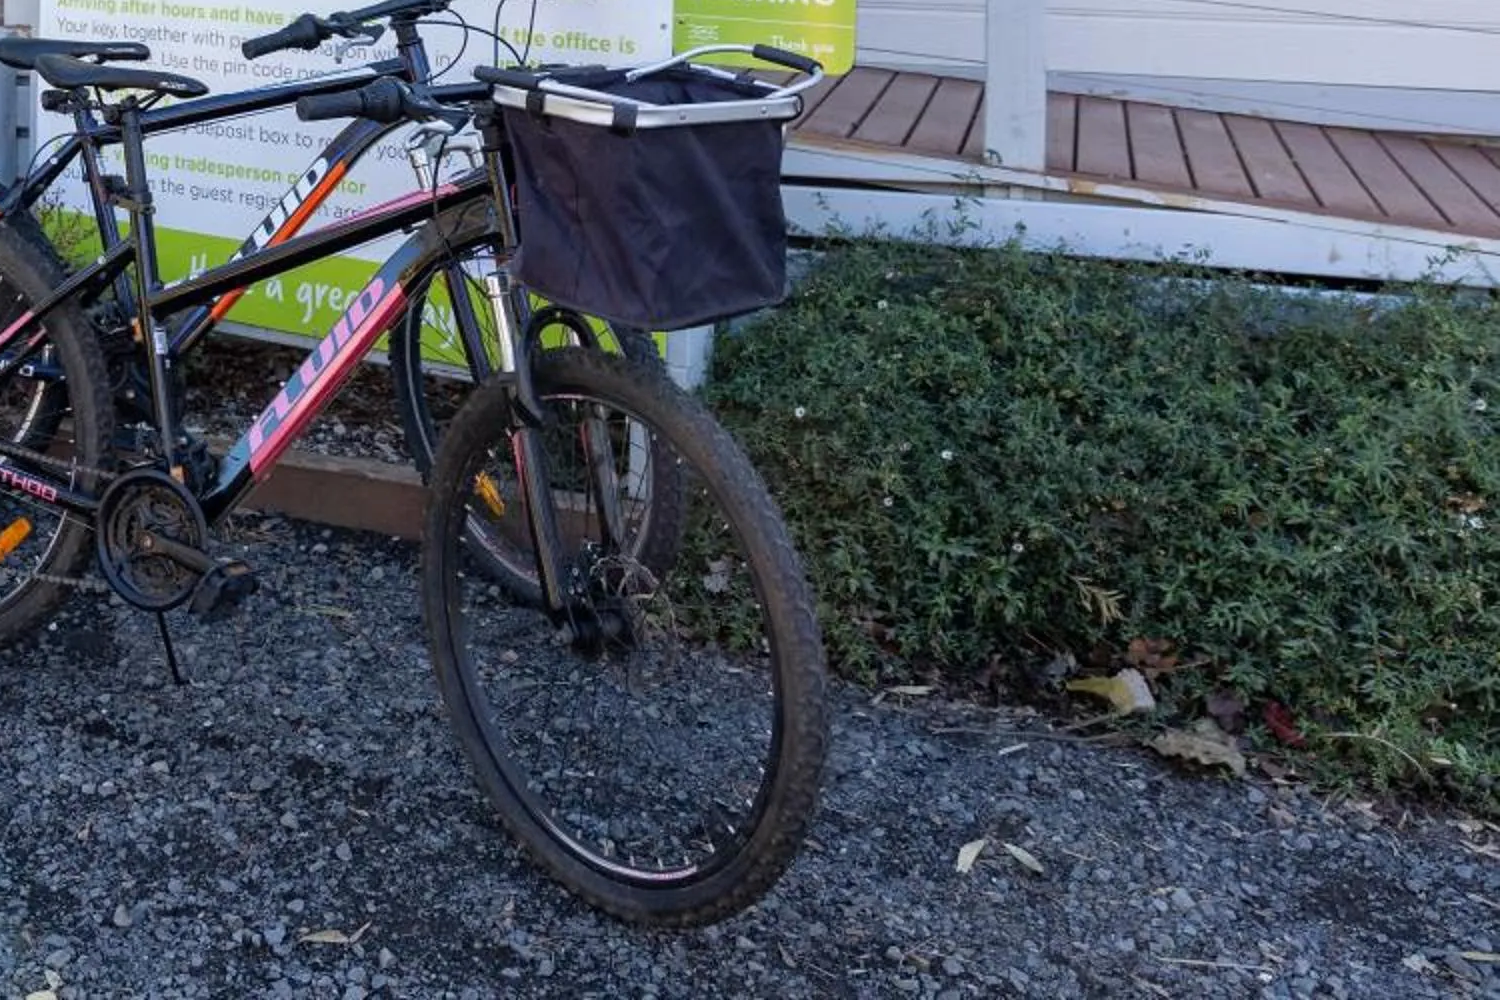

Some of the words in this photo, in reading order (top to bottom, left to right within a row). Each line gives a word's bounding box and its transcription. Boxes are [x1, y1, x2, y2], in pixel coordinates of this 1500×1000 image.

[161, 0, 204, 19] hours
[210, 4, 239, 22] and
[245, 7, 284, 25] have
[57, 17, 87, 34] Your
[92, 20, 119, 39] key,
[123, 24, 187, 44] together
[192, 28, 225, 46] with
[552, 31, 611, 52] office
[618, 36, 636, 54] is
[161, 52, 189, 70] Use
[193, 55, 218, 72] the
[223, 57, 247, 77] pin
[252, 60, 293, 78] code
[196, 121, 253, 140] deposit
[260, 126, 288, 145] box
[295, 132, 313, 148] to
[175, 156, 281, 183] tradesperson
[161, 177, 184, 194] the
[189, 185, 234, 204] guest
[239, 191, 282, 212] regis
[249, 278, 385, 451] FLUID
